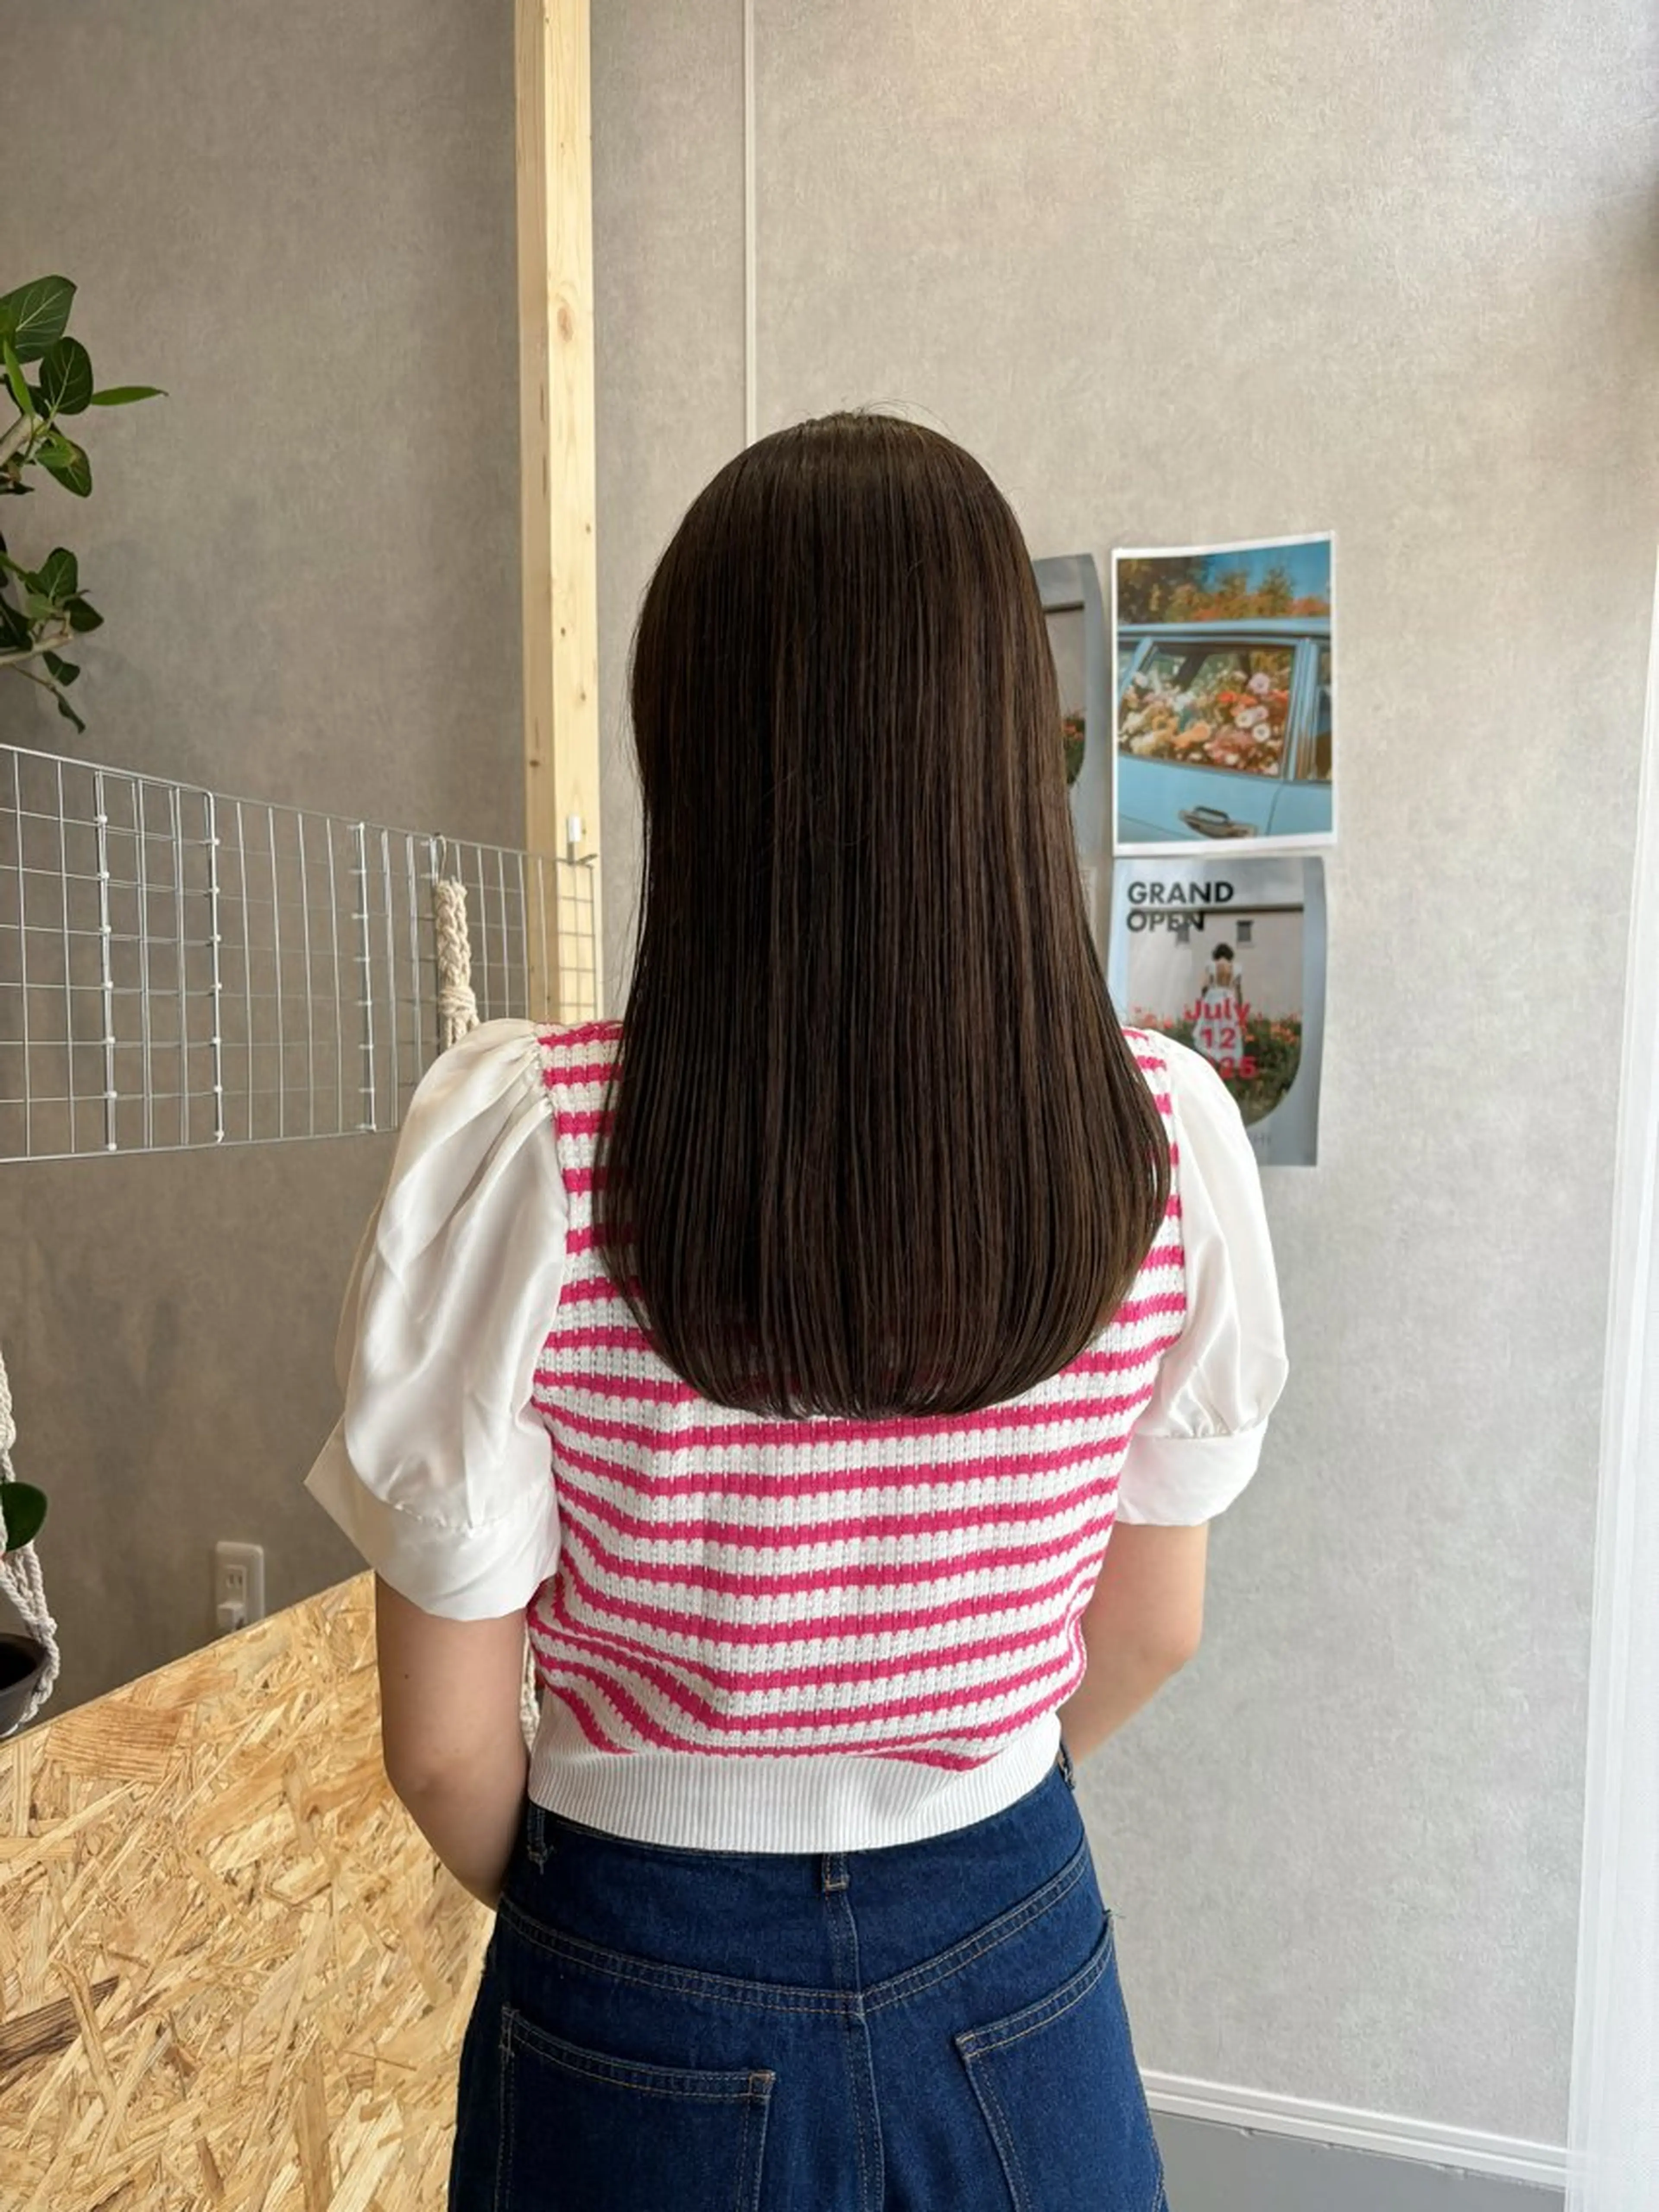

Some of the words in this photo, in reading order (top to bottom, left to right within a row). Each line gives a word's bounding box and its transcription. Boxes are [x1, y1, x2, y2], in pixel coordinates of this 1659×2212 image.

[1127, 881, 1234, 904] GRAND
[1126, 910, 1204, 932] OPEN
[1184, 998, 1250, 1027] July
[1201, 1027, 1236, 1049] 12
